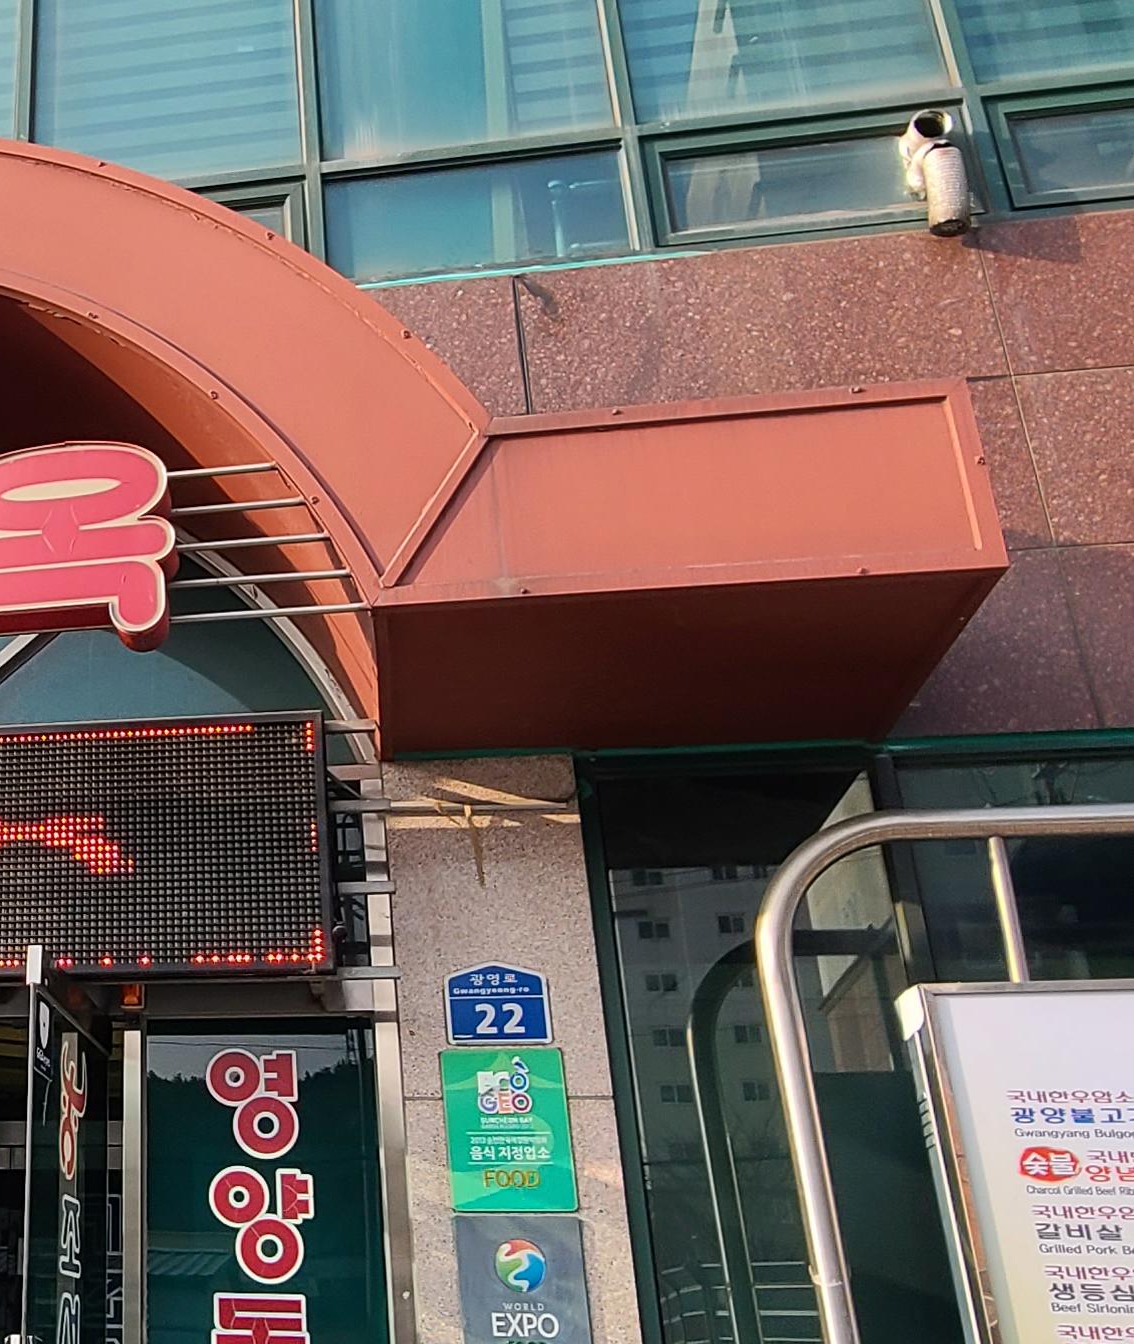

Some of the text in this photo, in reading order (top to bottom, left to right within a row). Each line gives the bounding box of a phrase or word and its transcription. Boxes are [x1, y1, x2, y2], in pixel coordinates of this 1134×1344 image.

[468, 973, 518, 986] 광영로
[475, 1002, 526, 1034] 22
[1014, 1127, 1091, 1139] Gwangyang
[469, 1145, 552, 1161] 음식 지정업소
[1022, 1151, 1076, 1177] 숯불
[482, 1168, 541, 1188] FOOD
[1063, 1185, 1093, 1196] Grilled
[1096, 1186, 1116, 1196] Beef
[1034, 1222, 1123, 1242] 갈비살
[1038, 1243, 1082, 1254] Grilled
[1086, 1244, 1118, 1255] Pork
[502, 1302, 545, 1311] WORLD
[1050, 1302, 1082, 1313] Beef
[491, 1312, 560, 1338] EXPO
